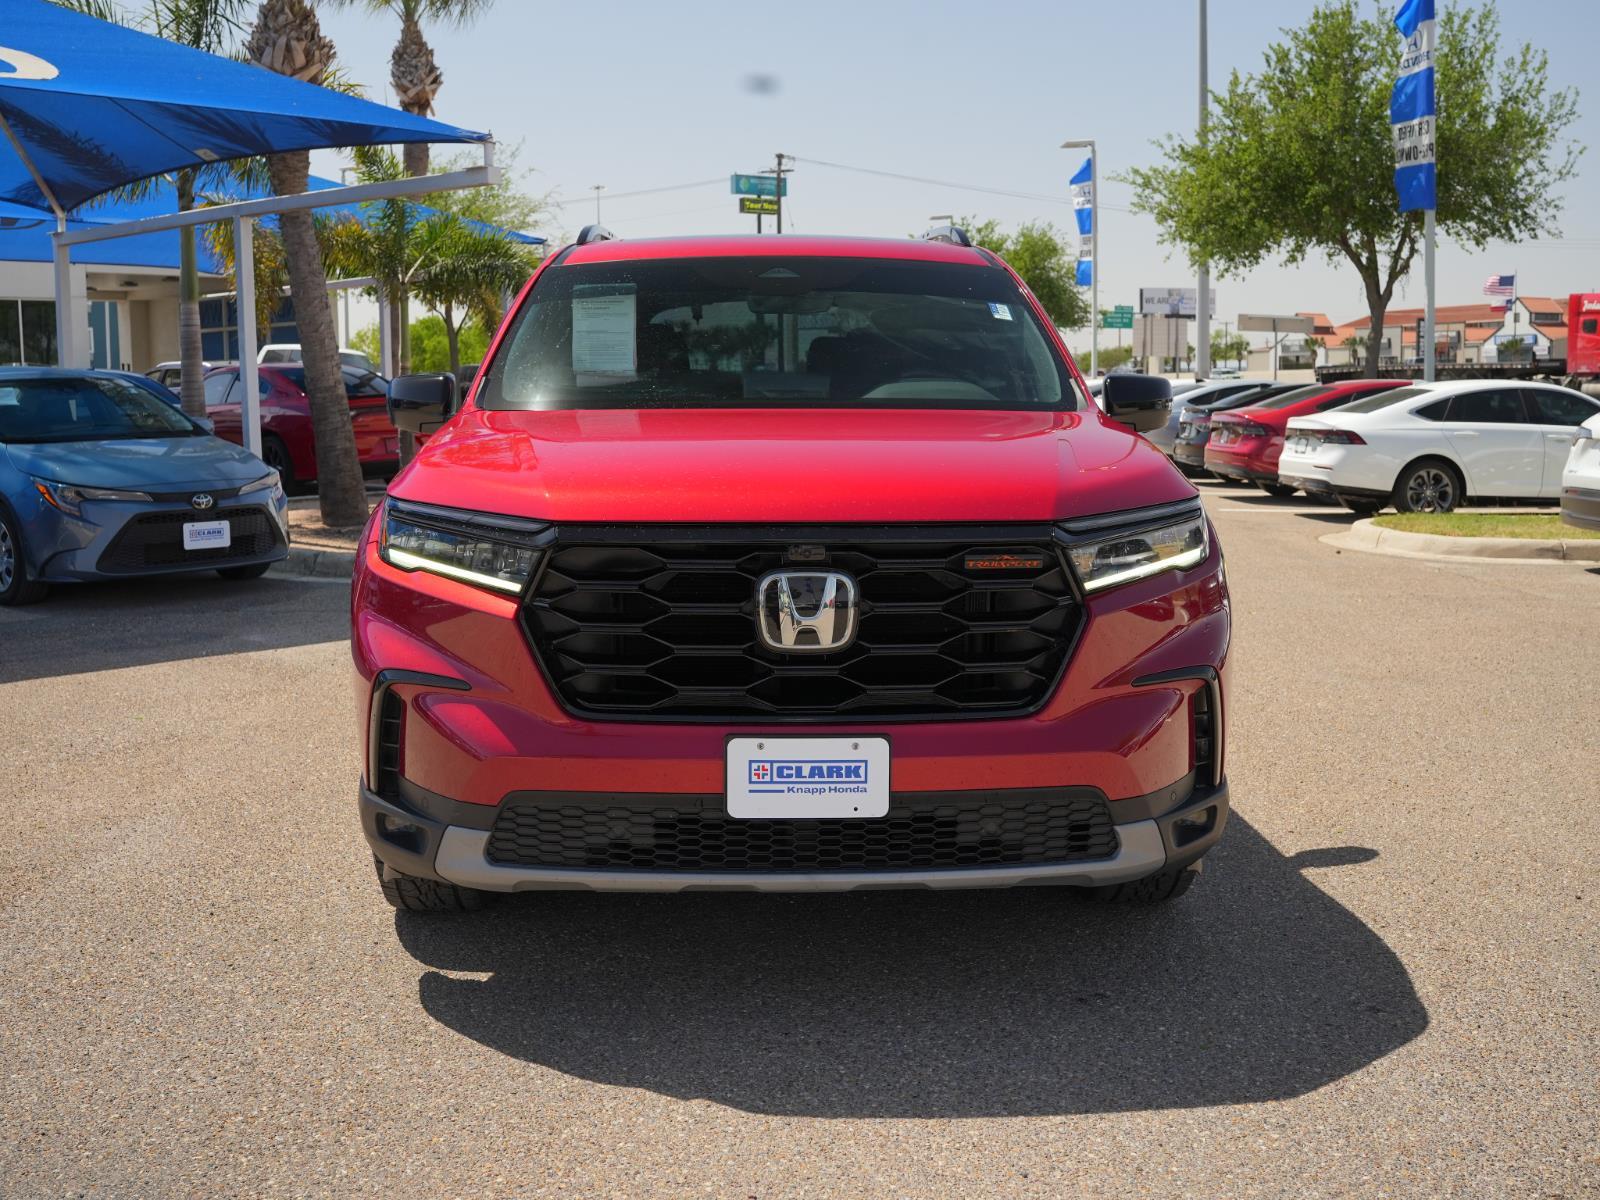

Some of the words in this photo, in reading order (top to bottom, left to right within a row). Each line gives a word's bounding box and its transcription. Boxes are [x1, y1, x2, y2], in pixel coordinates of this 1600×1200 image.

[776, 765, 862, 779] CLARK
[787, 786, 826, 795] Knapp
[828, 785, 867, 793] Honda
